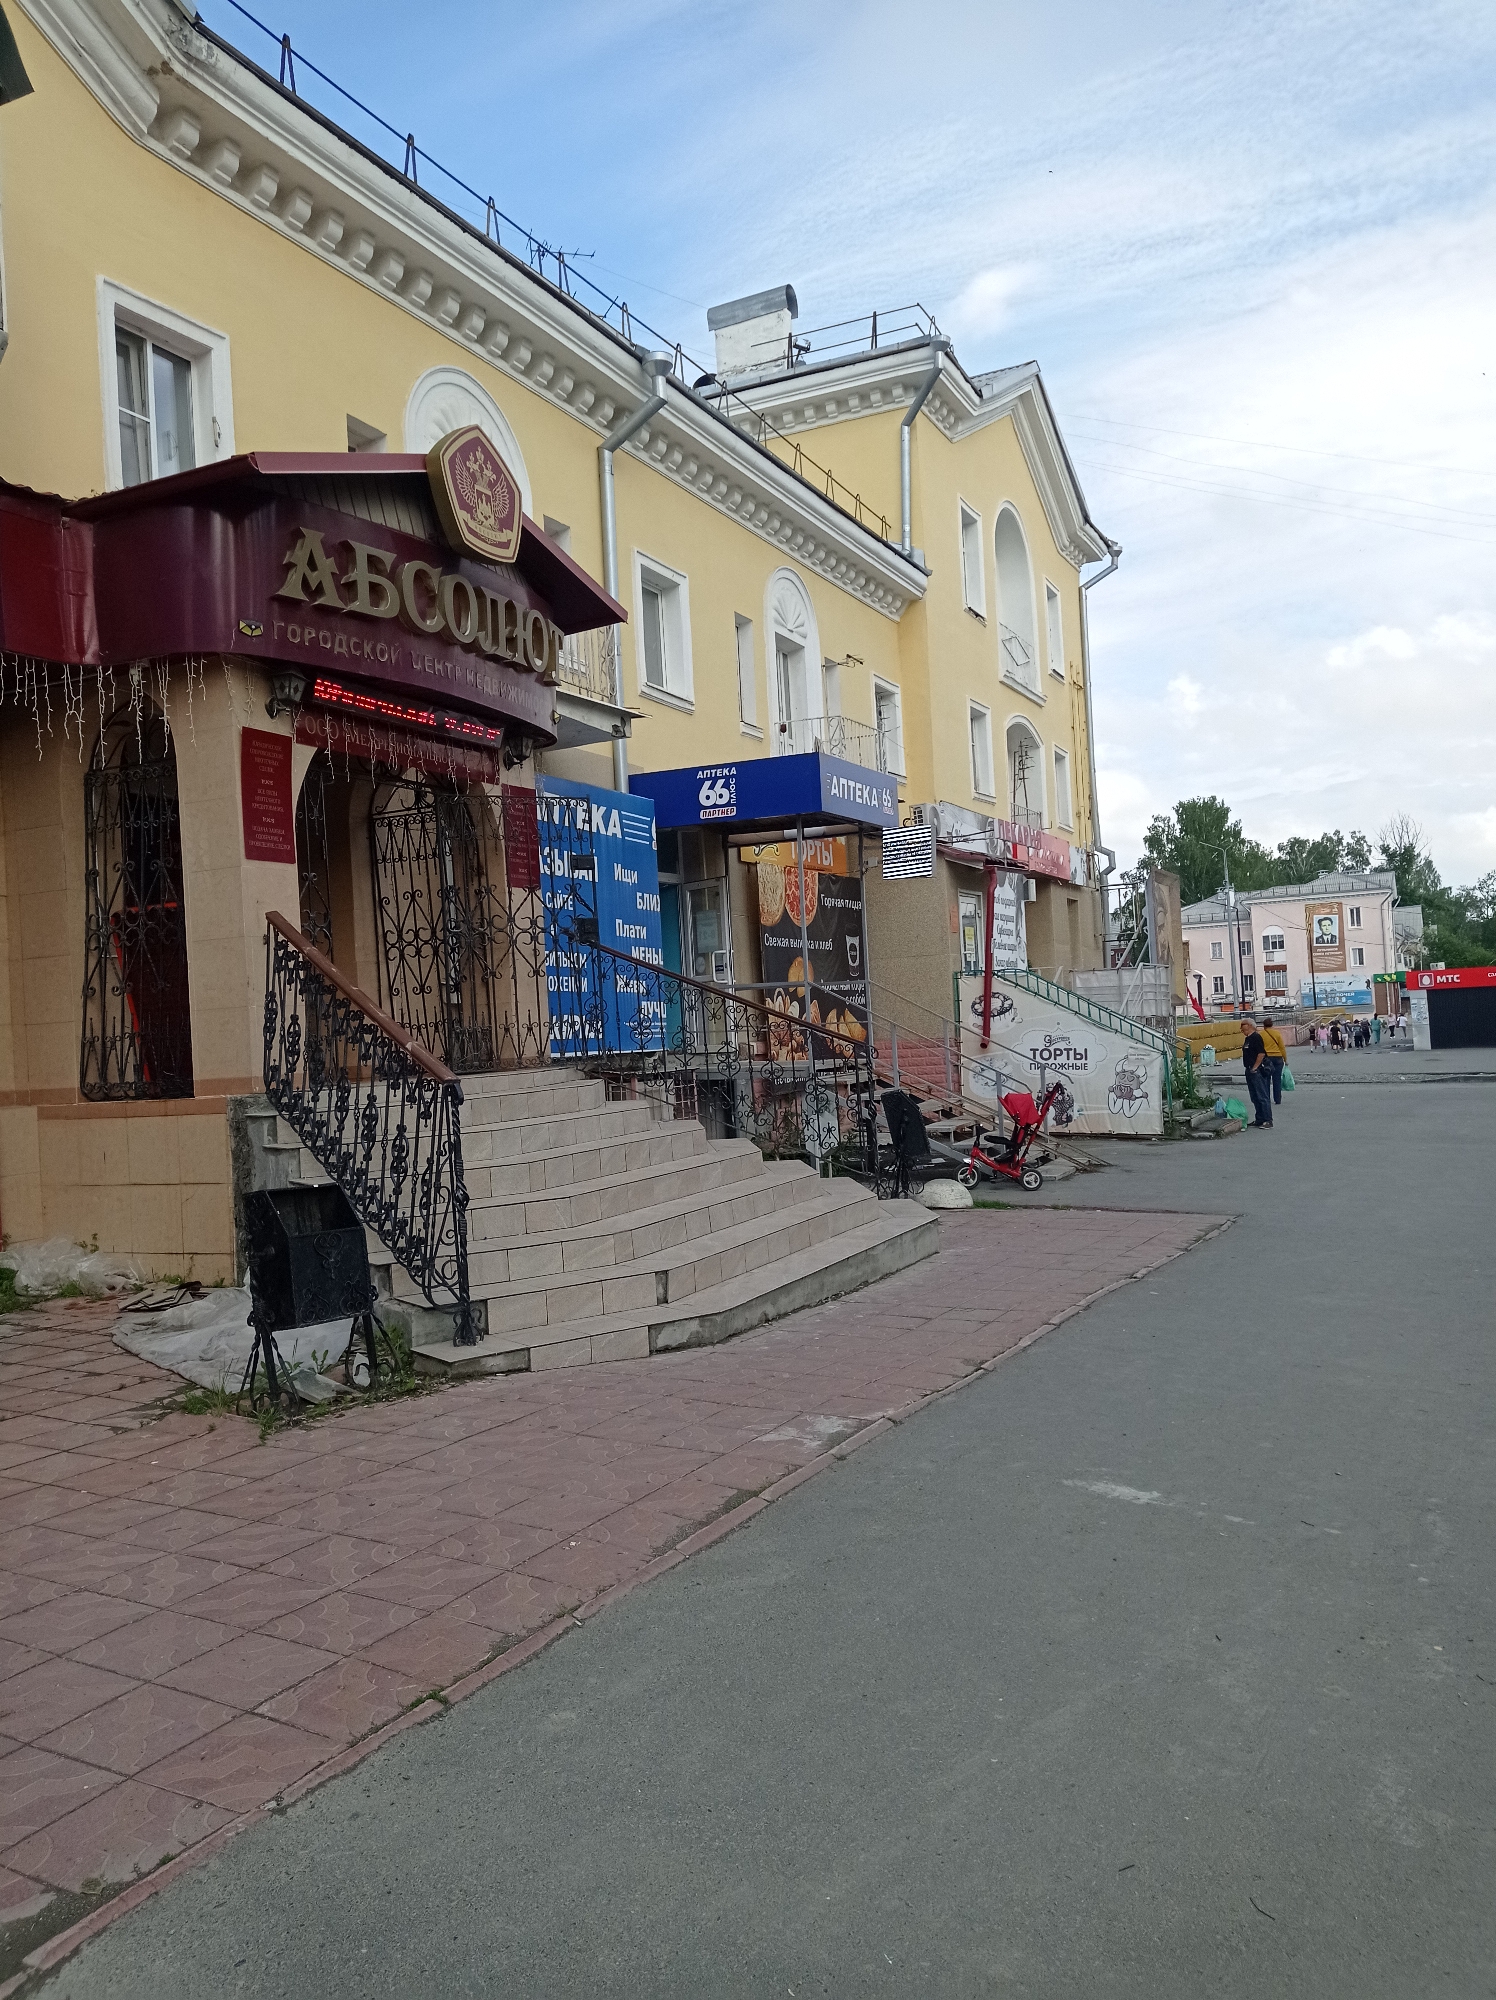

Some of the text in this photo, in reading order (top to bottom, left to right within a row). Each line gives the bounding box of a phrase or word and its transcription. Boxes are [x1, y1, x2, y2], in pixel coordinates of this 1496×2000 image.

[273, 527, 564, 686] АБСОЛЮТ
[272, 620, 400, 664] ГОРОДСКОЙ
[411, 651, 462, 679] ЦЕНТР
[697, 766, 737, 779] АПТЕКА
[699, 778, 730, 806] 66
[830, 775, 879, 808] АПТЕКА
[702, 807, 736, 818] ПАРТНЕР
[613, 862, 638, 886] Ищи
[615, 919, 647, 940] Плати
[764, 934, 790, 948] Свежая
[1436, 975, 1461, 983] МТС
[1029, 1048, 1088, 1061] ТОРТЫ
[1029, 1062, 1088, 1071] ПИРОЖНЫЕ
